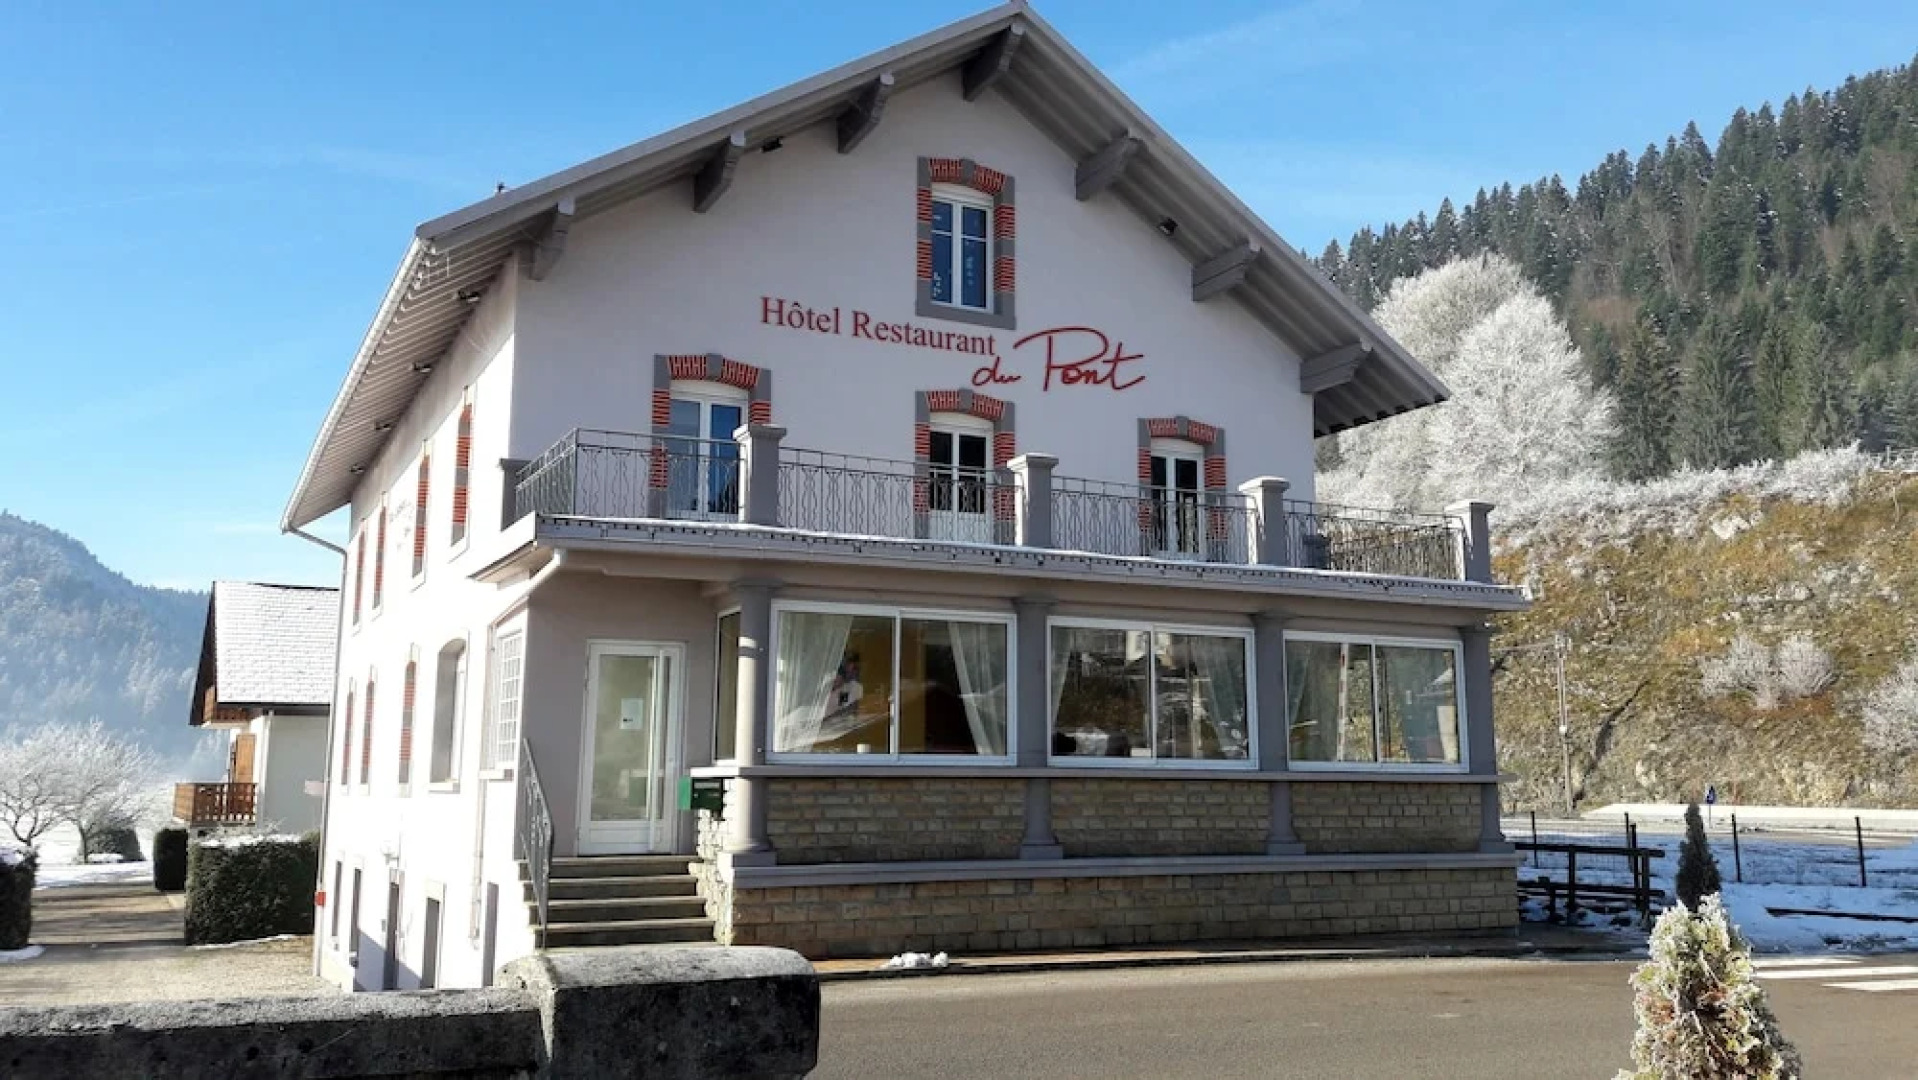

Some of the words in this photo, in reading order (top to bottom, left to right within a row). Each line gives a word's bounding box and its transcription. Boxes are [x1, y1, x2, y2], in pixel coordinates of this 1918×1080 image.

[760, 296, 841, 334] Hôtel
[851, 310, 996, 355] Restaurant
[972, 356, 1021, 386] du
[1012, 325, 1146, 391] Pont
